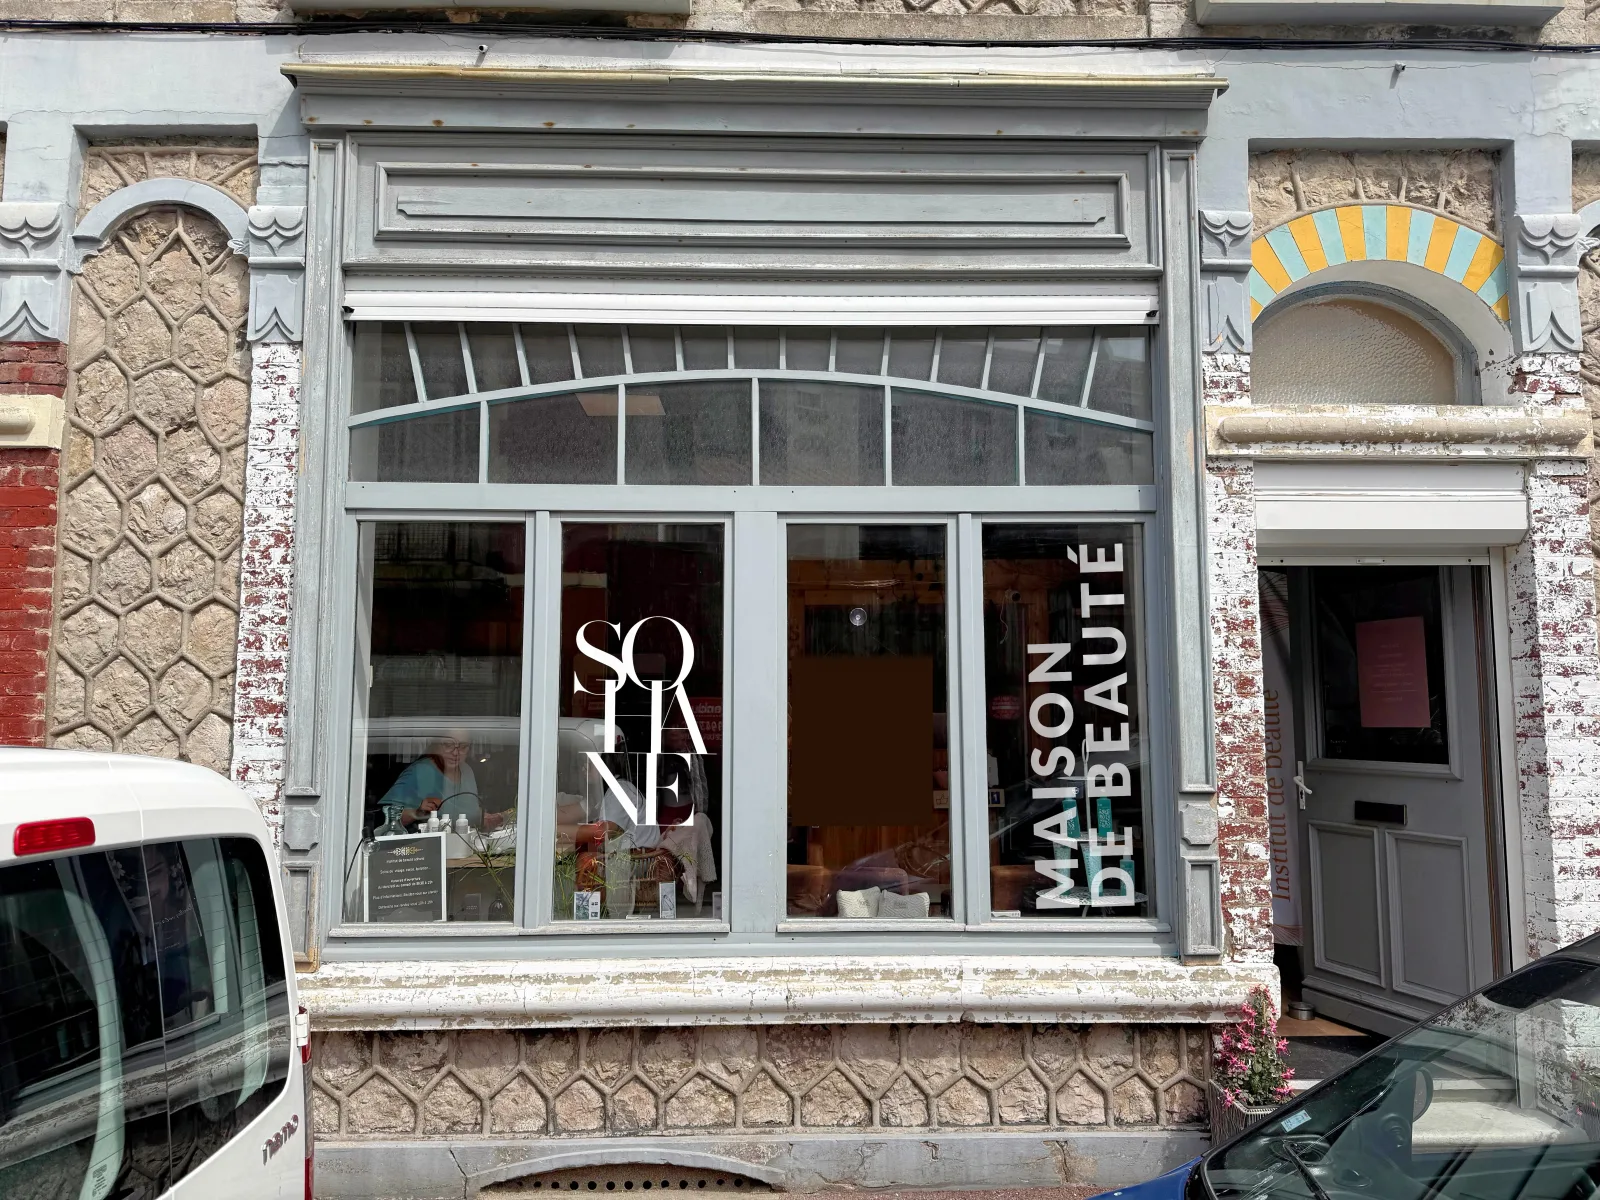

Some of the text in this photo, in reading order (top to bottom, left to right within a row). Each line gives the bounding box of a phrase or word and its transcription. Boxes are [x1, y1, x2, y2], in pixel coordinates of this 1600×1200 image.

[1027, 642, 1081, 910] MAISON
[1067, 542, 1135, 909] DE BEAUTÉ
[1267, 776, 1285, 806] de
[1269, 813, 1291, 902] Institut
